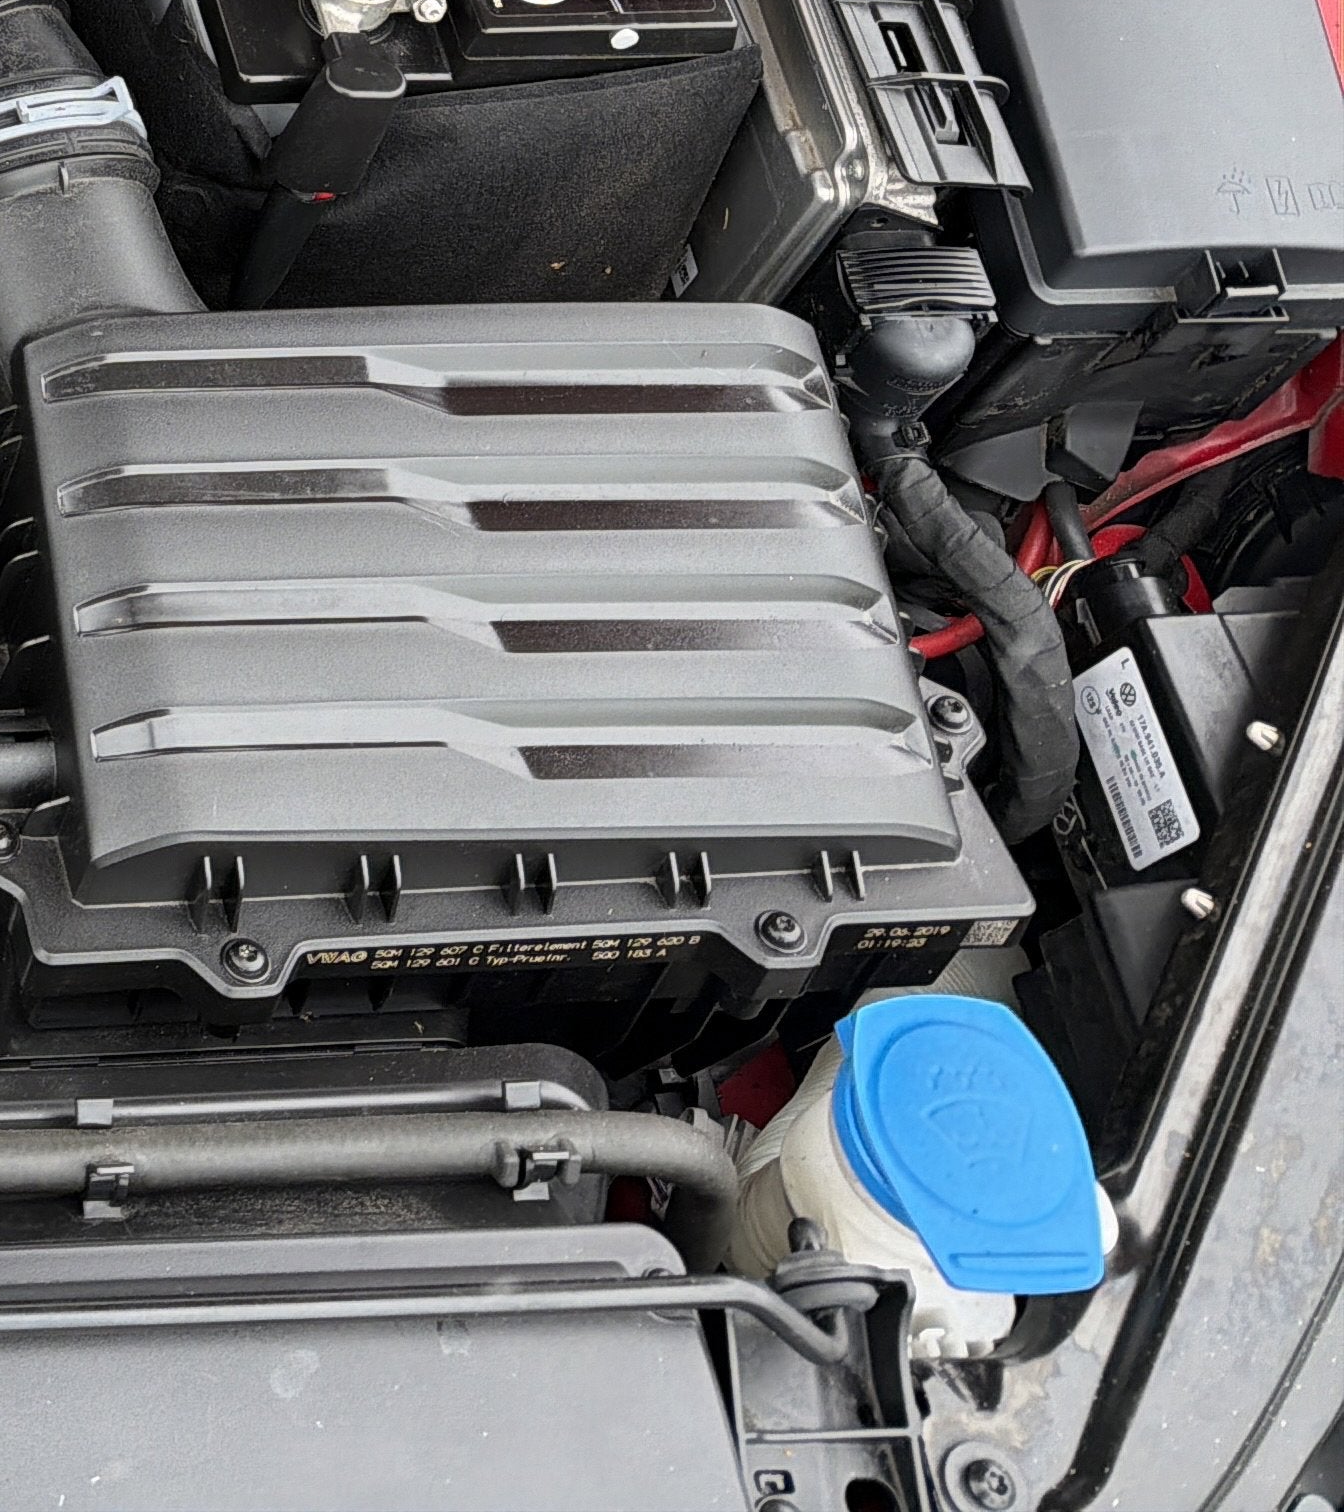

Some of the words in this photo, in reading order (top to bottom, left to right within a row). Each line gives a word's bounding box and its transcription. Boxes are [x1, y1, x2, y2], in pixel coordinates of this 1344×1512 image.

[1121, 657, 1131, 670] L
[410, 948, 433, 957] 129
[440, 946, 466, 956] 607
[472, 945, 484, 954] C
[488, 940, 588, 954] Filterelement
[626, 937, 650, 948] 129
[657, 935, 685, 946] 620
[689, 935, 702, 945] B
[406, 958, 431, 969] 129
[436, 957, 461, 967] 601
[468, 956, 480, 966] C
[626, 949, 653, 959] 183
[655, 948, 668, 958] A
